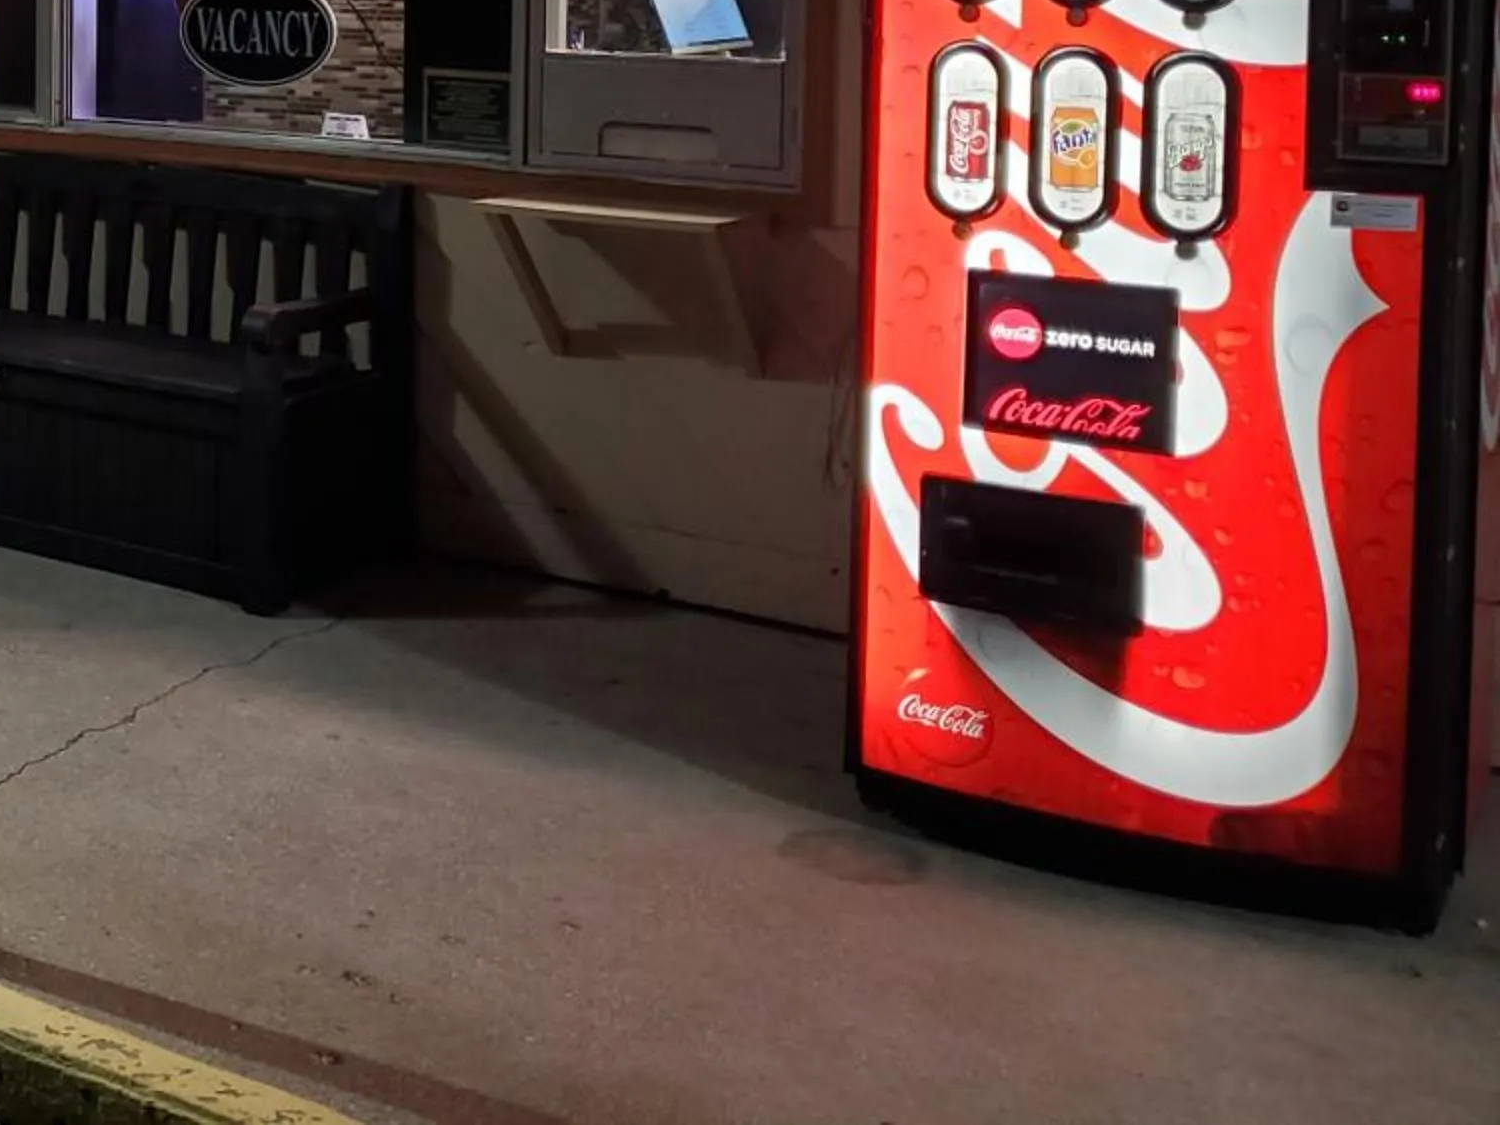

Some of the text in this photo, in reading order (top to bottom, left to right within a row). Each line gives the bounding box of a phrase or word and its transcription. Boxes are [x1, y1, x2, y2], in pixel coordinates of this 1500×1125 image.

[196, 6, 320, 59] VACANCY
[1044, 329, 1094, 351] zero
[1095, 336, 1156, 359] SUGAR
[988, 388, 1153, 441] Coca-Cola
[897, 693, 990, 740] Coca-Cola
